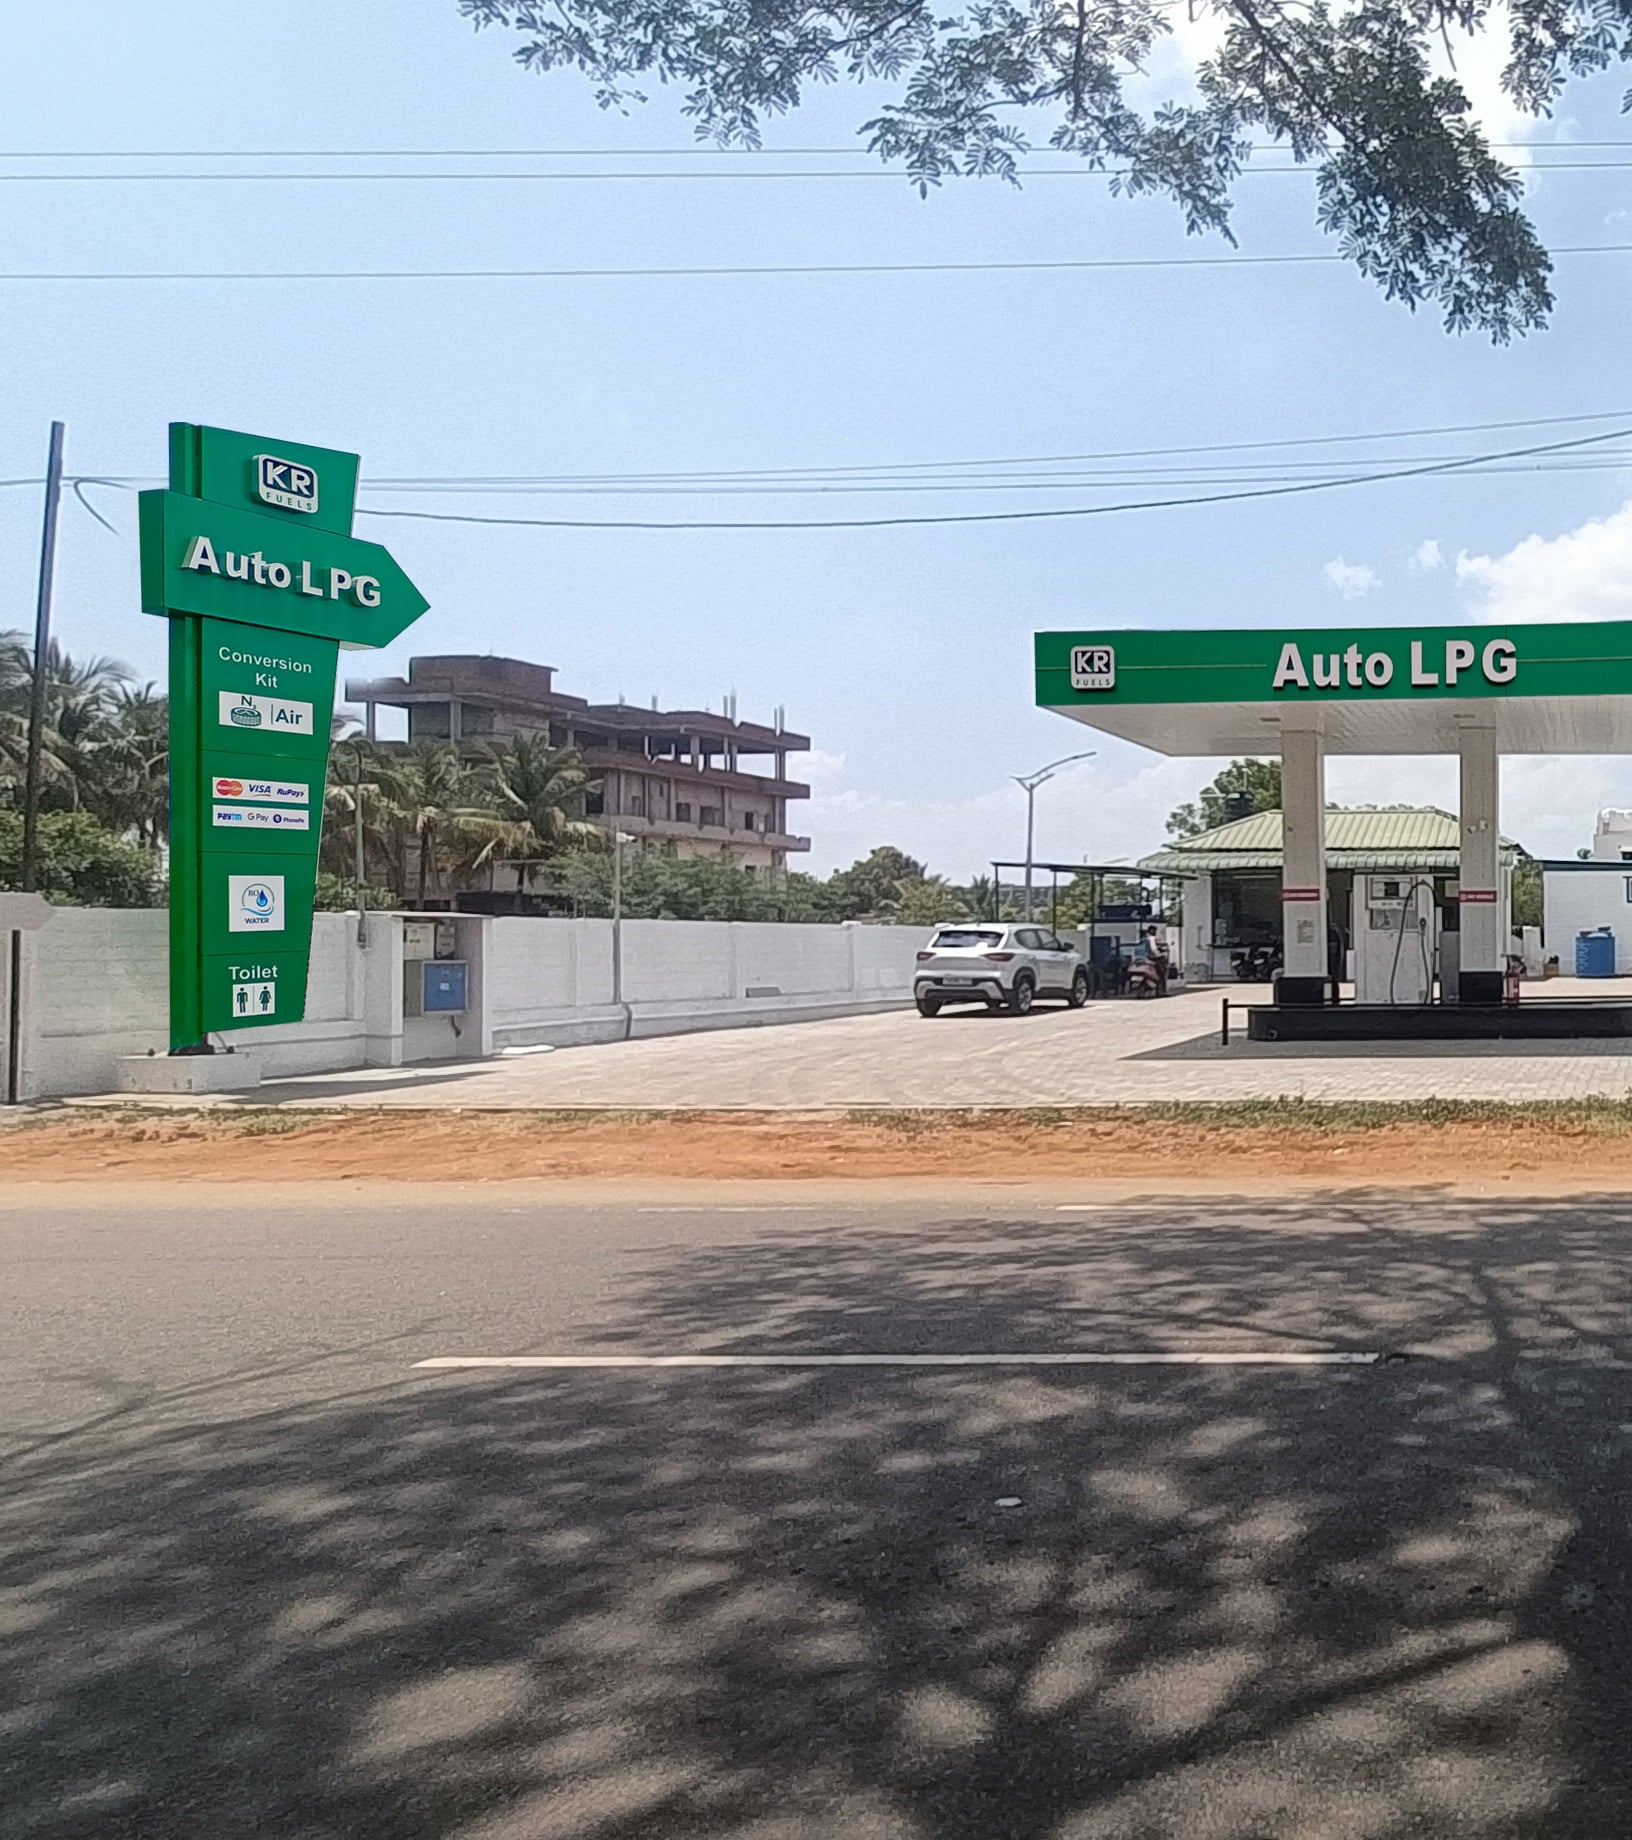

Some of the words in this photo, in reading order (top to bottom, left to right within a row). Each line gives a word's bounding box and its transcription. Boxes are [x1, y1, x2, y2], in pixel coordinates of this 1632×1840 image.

[266, 461, 312, 496] KR
[266, 492, 312, 511] FUELS
[183, 536, 291, 589] Auto
[299, 560, 381, 607] LPG
[219, 646, 313, 674] Conversion
[1077, 652, 1109, 672] KR
[1272, 642, 1394, 688] Auto
[1410, 639, 1517, 685] LPG
[255, 672, 279, 688] Kit
[1076, 678, 1110, 687] FUELS
[275, 708, 303, 725] Air
[248, 784, 272, 793] VISA
[276, 788, 300, 798] RuPay
[256, 813, 270, 823] Pay
[248, 889, 259, 897] RO
[244, 917, 270, 925] WATER
[228, 965, 278, 981] Toilet
